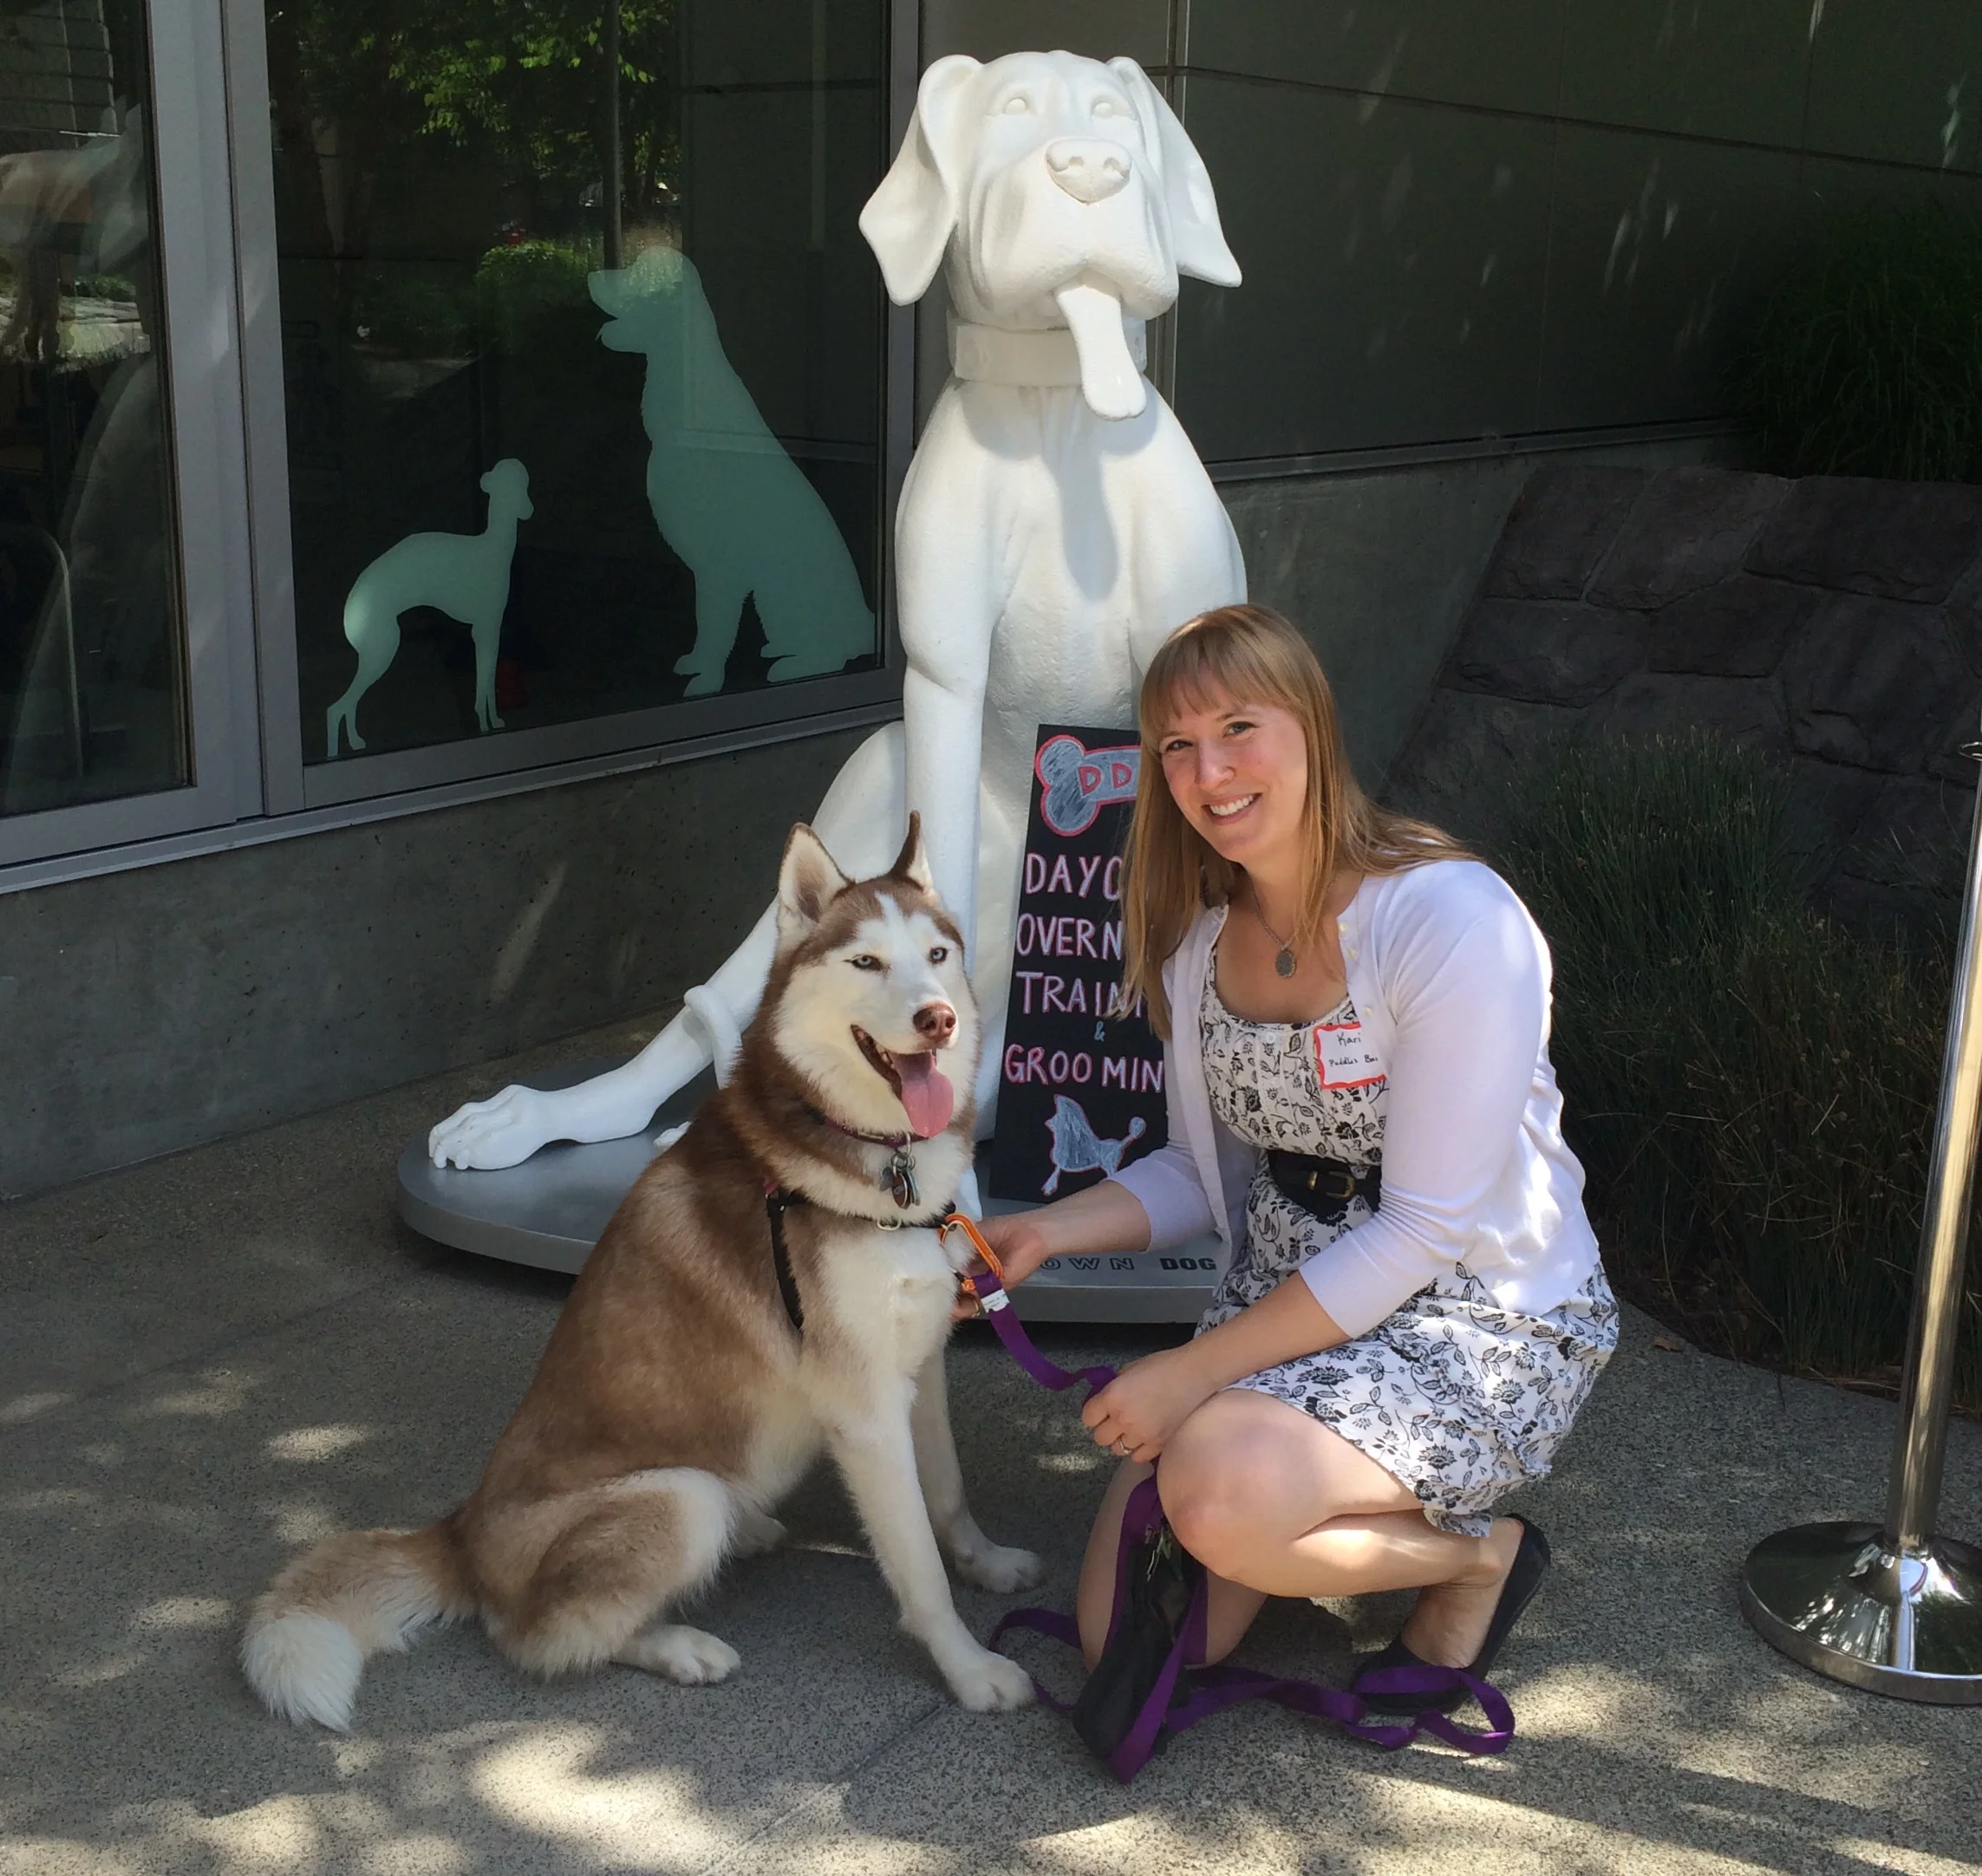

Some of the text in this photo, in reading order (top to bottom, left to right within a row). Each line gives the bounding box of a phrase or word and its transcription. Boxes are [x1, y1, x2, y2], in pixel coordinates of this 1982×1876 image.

[1016, 913, 1123, 961] OVERN
[1093, 1020, 1105, 1042] &
[1336, 1032, 1362, 1046] Kari
[1160, 1257, 1217, 1271] DOG
